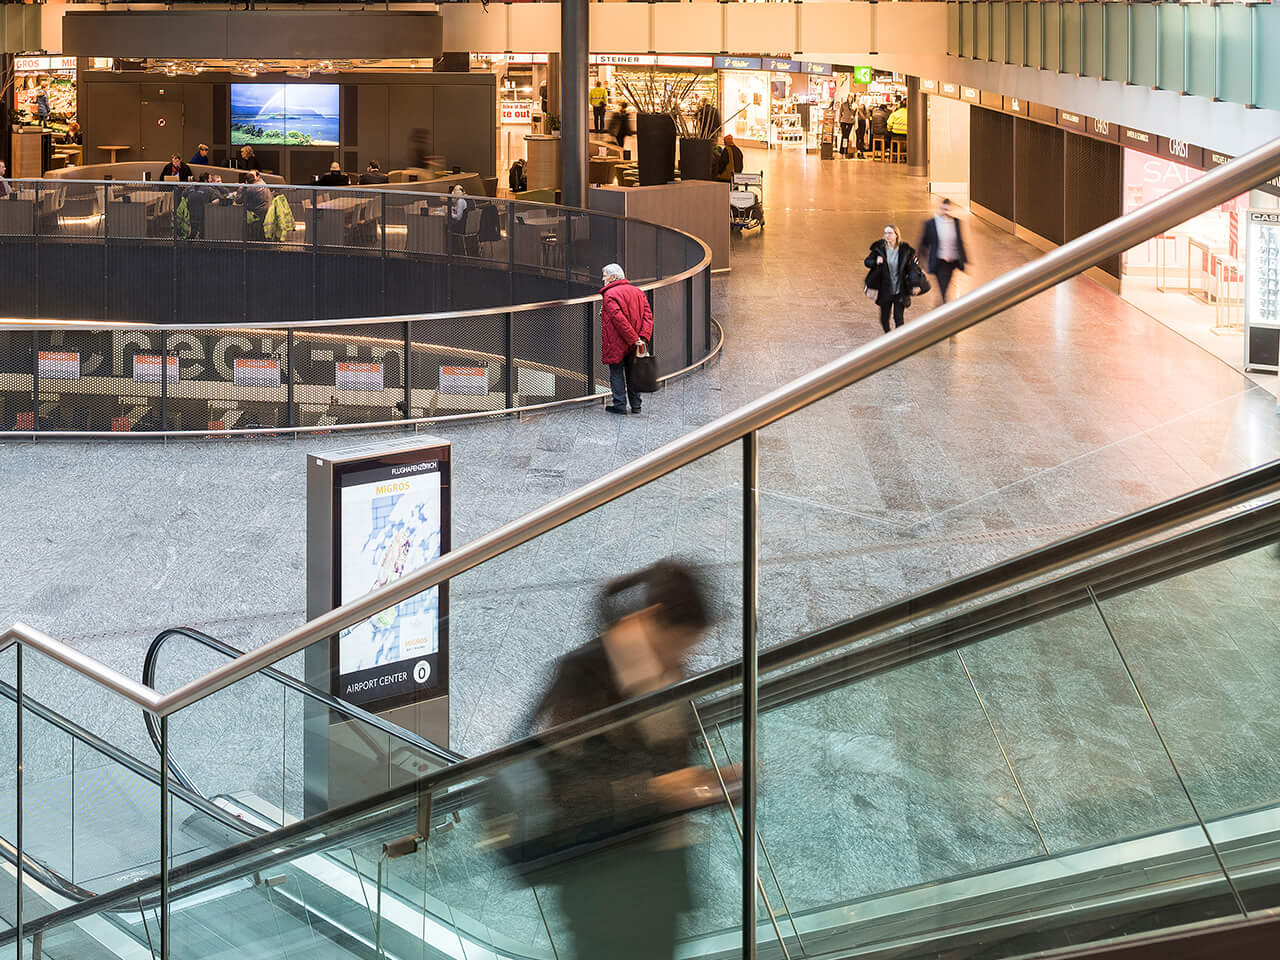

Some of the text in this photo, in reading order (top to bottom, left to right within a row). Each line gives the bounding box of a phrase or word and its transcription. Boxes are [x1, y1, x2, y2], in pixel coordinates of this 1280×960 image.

[16, 59, 39, 68] GROS
[514, 110, 530, 118] out
[1169, 137, 1189, 159] CHRIST
[1144, 161, 1196, 183] SAL
[375, 481, 410, 495] MIGROS
[346, 678, 378, 694] AIRPORT
[378, 671, 408, 686] CENTER
